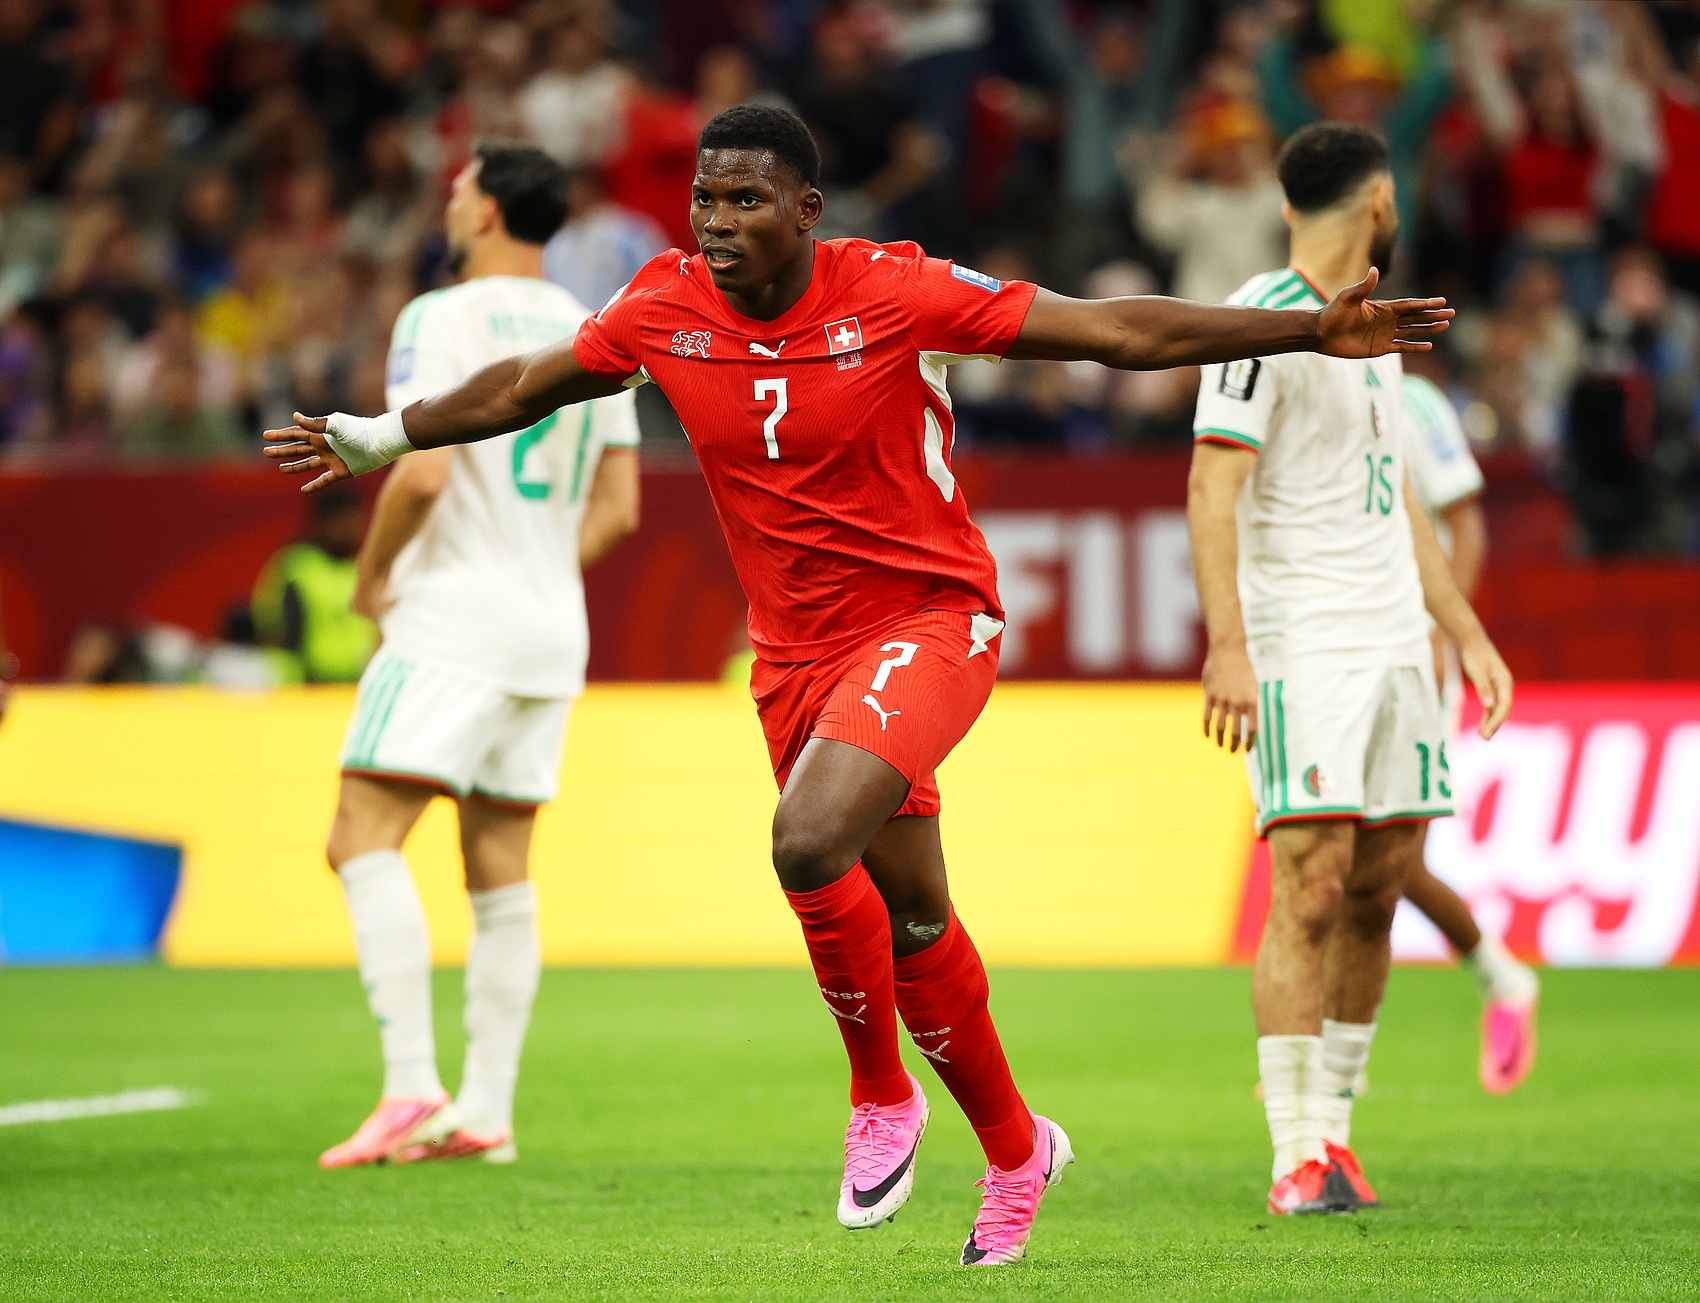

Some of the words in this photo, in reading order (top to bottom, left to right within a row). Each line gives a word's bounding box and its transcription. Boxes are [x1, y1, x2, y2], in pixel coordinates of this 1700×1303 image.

[753, 377, 789, 460] 7
[1364, 452, 1393, 516] 15
[981, 513, 1203, 670] FIF
[869, 640, 922, 693] 7
